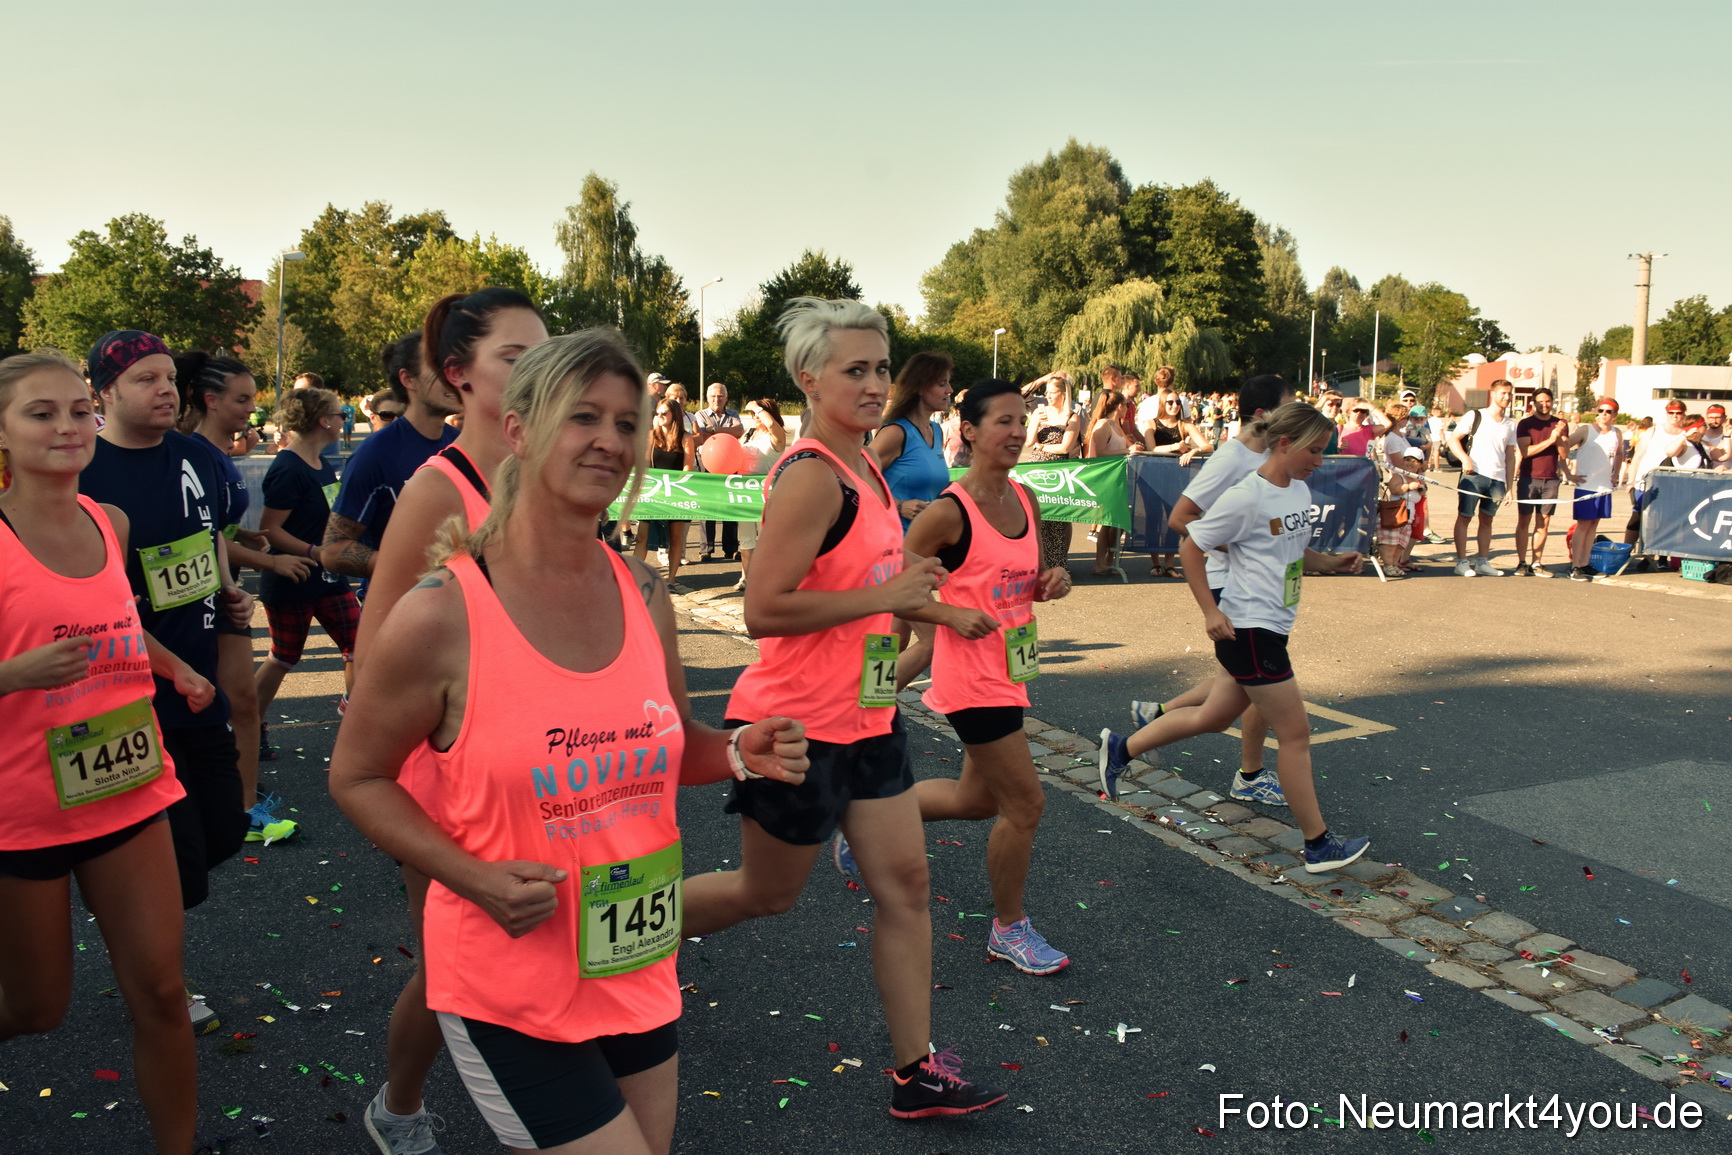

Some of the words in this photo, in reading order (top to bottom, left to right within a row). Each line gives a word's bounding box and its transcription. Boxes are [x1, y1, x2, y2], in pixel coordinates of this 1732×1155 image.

[724, 474, 773, 491] Ges
[728, 492, 753, 504] in
[1037, 493, 1101, 509] dheitskasse.
[1284, 509, 1311, 532] GRA
[1309, 504, 1336, 523] er
[1312, 527, 1323, 537] E
[1719, 539, 1732, 550] A
[158, 554, 213, 590] 1612
[113, 616, 132, 630] mit
[86, 633, 148, 662] VITA
[546, 727, 617, 757] Pflegen
[625, 721, 654, 740] mit
[69, 730, 149, 781] 1449
[94, 773, 121, 787] Slotta
[122, 765, 140, 776] Nina
[531, 745, 667, 799] NOVITA
[539, 780, 665, 820] Seniorenzentrum
[600, 883, 676, 944] 1451
[612, 941, 635, 956] Engl
[637, 927, 674, 948] Alexandra
